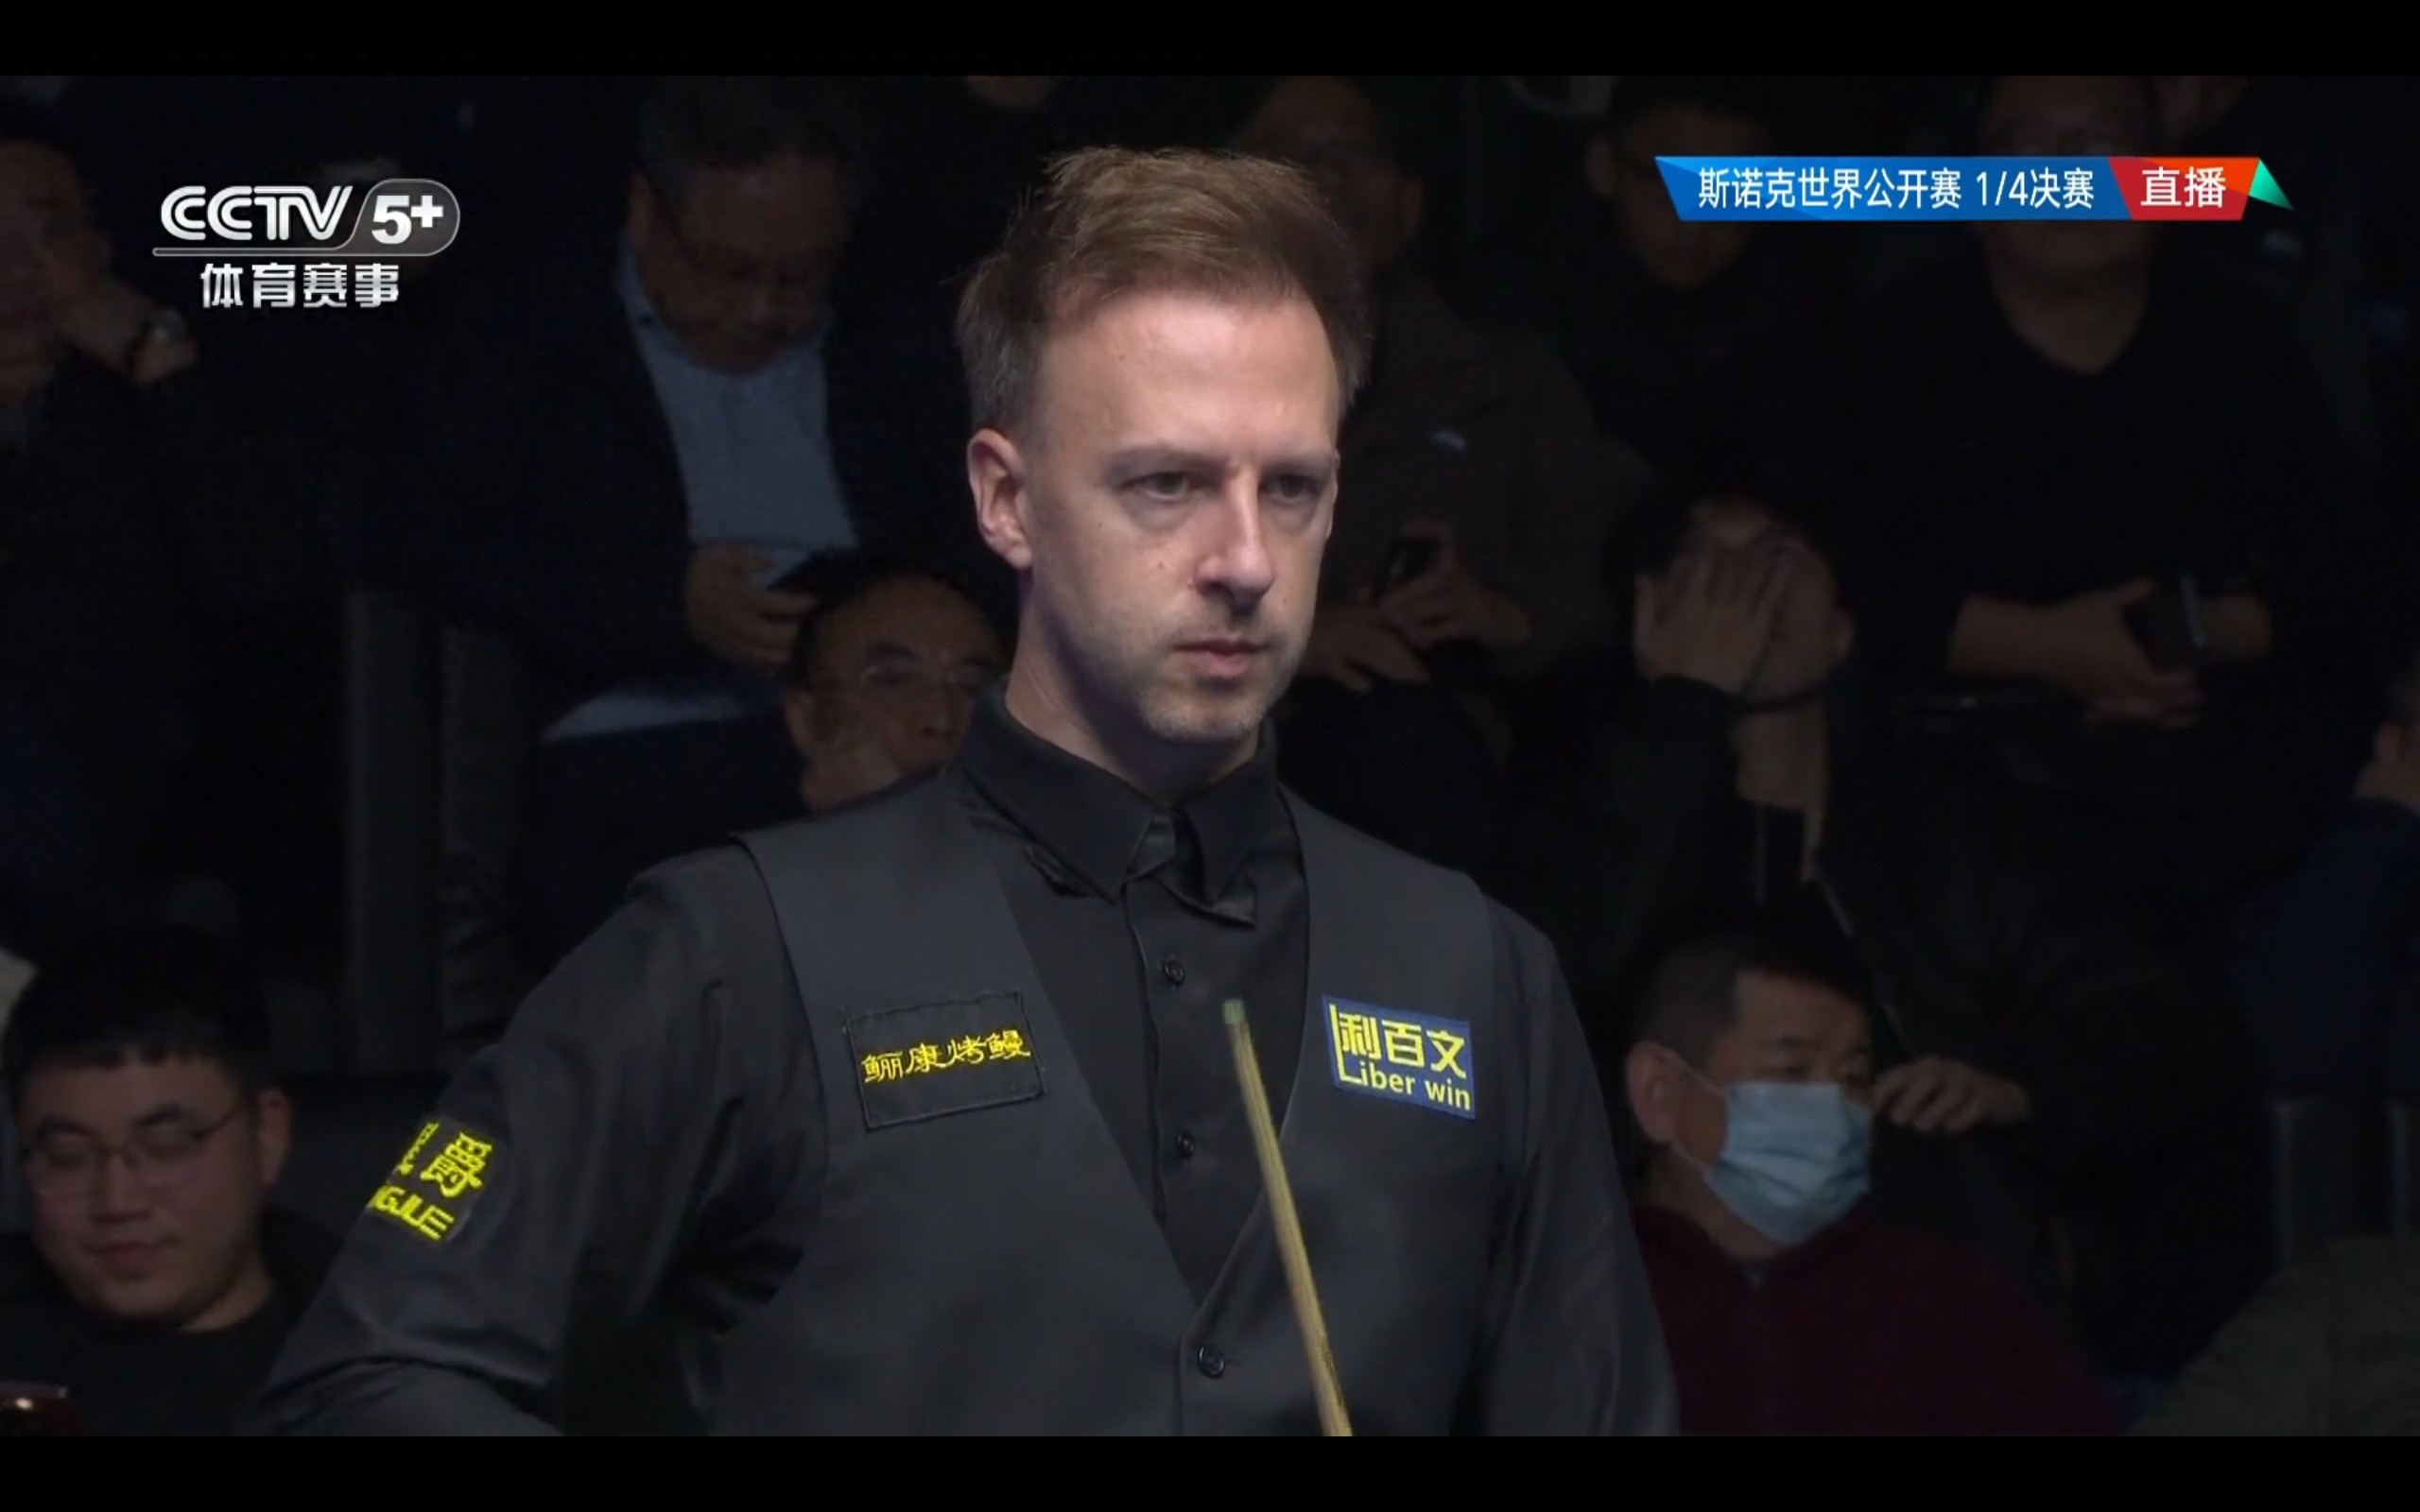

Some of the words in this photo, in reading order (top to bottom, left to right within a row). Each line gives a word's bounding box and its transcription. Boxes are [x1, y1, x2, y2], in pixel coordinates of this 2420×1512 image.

[1329, 1004, 1416, 1095] Liber
[1425, 1078, 1471, 1110] win
[1338, 1011, 1467, 1079] 利百文
[367, 1184, 455, 1240] GJUE
